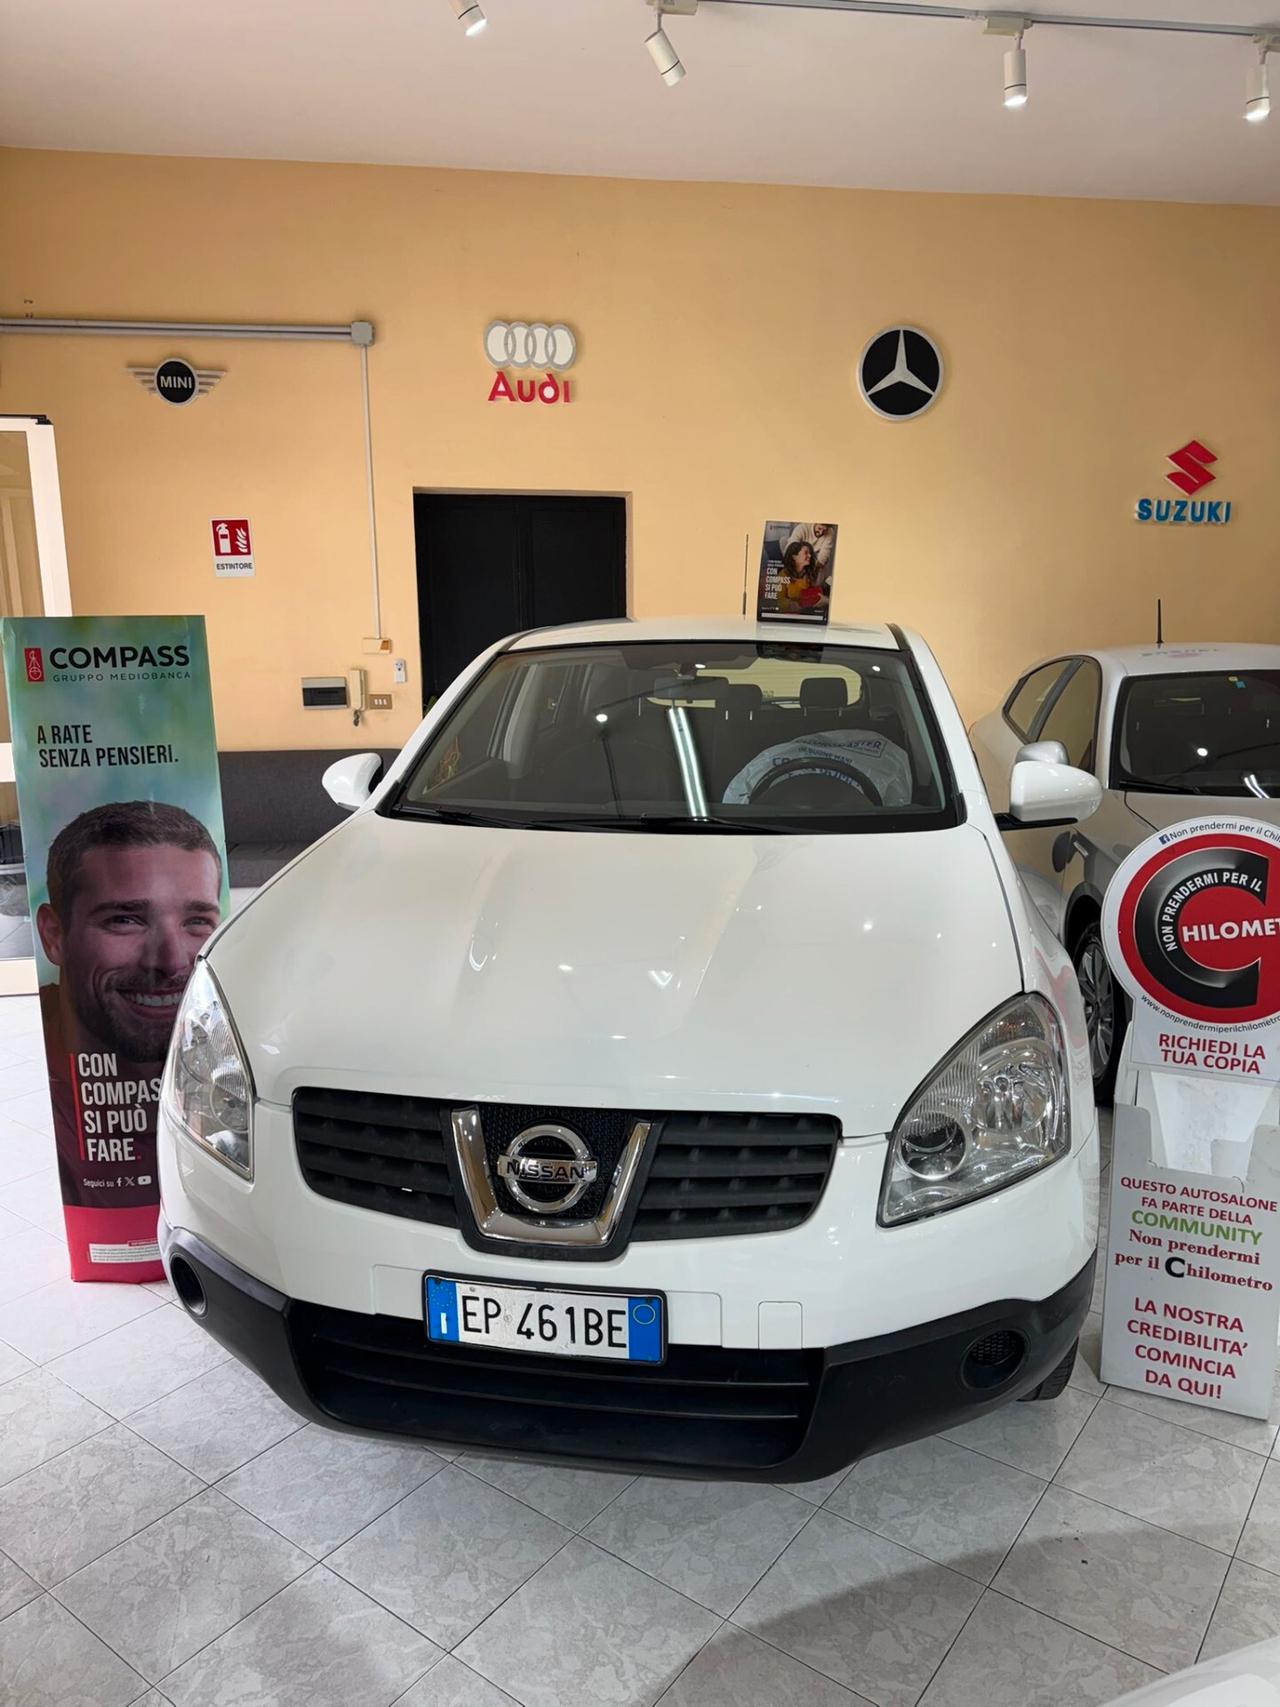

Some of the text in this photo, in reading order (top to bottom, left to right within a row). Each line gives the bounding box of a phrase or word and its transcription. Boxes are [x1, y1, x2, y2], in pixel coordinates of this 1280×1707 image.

[160, 376, 192, 388] MINI
[488, 371, 570, 404] Audi
[1136, 498, 1231, 523] SUZUKI
[216, 562, 253, 570] ESTINTORE
[50, 646, 190, 669] COMPASS
[53, 672, 191, 682] GRUPPO MEDIOBANCA
[38, 724, 93, 744] A RATE
[40, 744, 179, 768] SENZA PENSIERI.
[1169, 821, 1280, 844] Non prendermi per il Chil
[1161, 871, 1263, 952] NON PRENDERMI PER IL
[1159, 1033, 1266, 1060] RICHIEDI LA
[78, 1053, 118, 1077] CON
[1161, 1049, 1260, 1075] TUA COPIA
[84, 1103, 147, 1133] SI PUÒ
[83, 1178, 105, 1188] Seguici
[506, 1160, 585, 1180] NISSAN
[1120, 1176, 1278, 1212] QUESTO AUTOSALONE
[1141, 1197, 1253, 1225] FA PARTE DELLA
[1131, 1210, 1263, 1246] COMMUNITY
[1129, 1229, 1261, 1266] Non prendermi
[1114, 1252, 1273, 1292] per il Chilometro
[462, 1295, 501, 1334] EP
[516, 1302, 627, 1349] 461BE
[1134, 1297, 1244, 1333] LA NOSTRA
[1127, 1319, 1249, 1357] CREDIBILITA'
[1135, 1344, 1237, 1379] COMINCIA
[1145, 1369, 1222, 1400] DA QUI!
